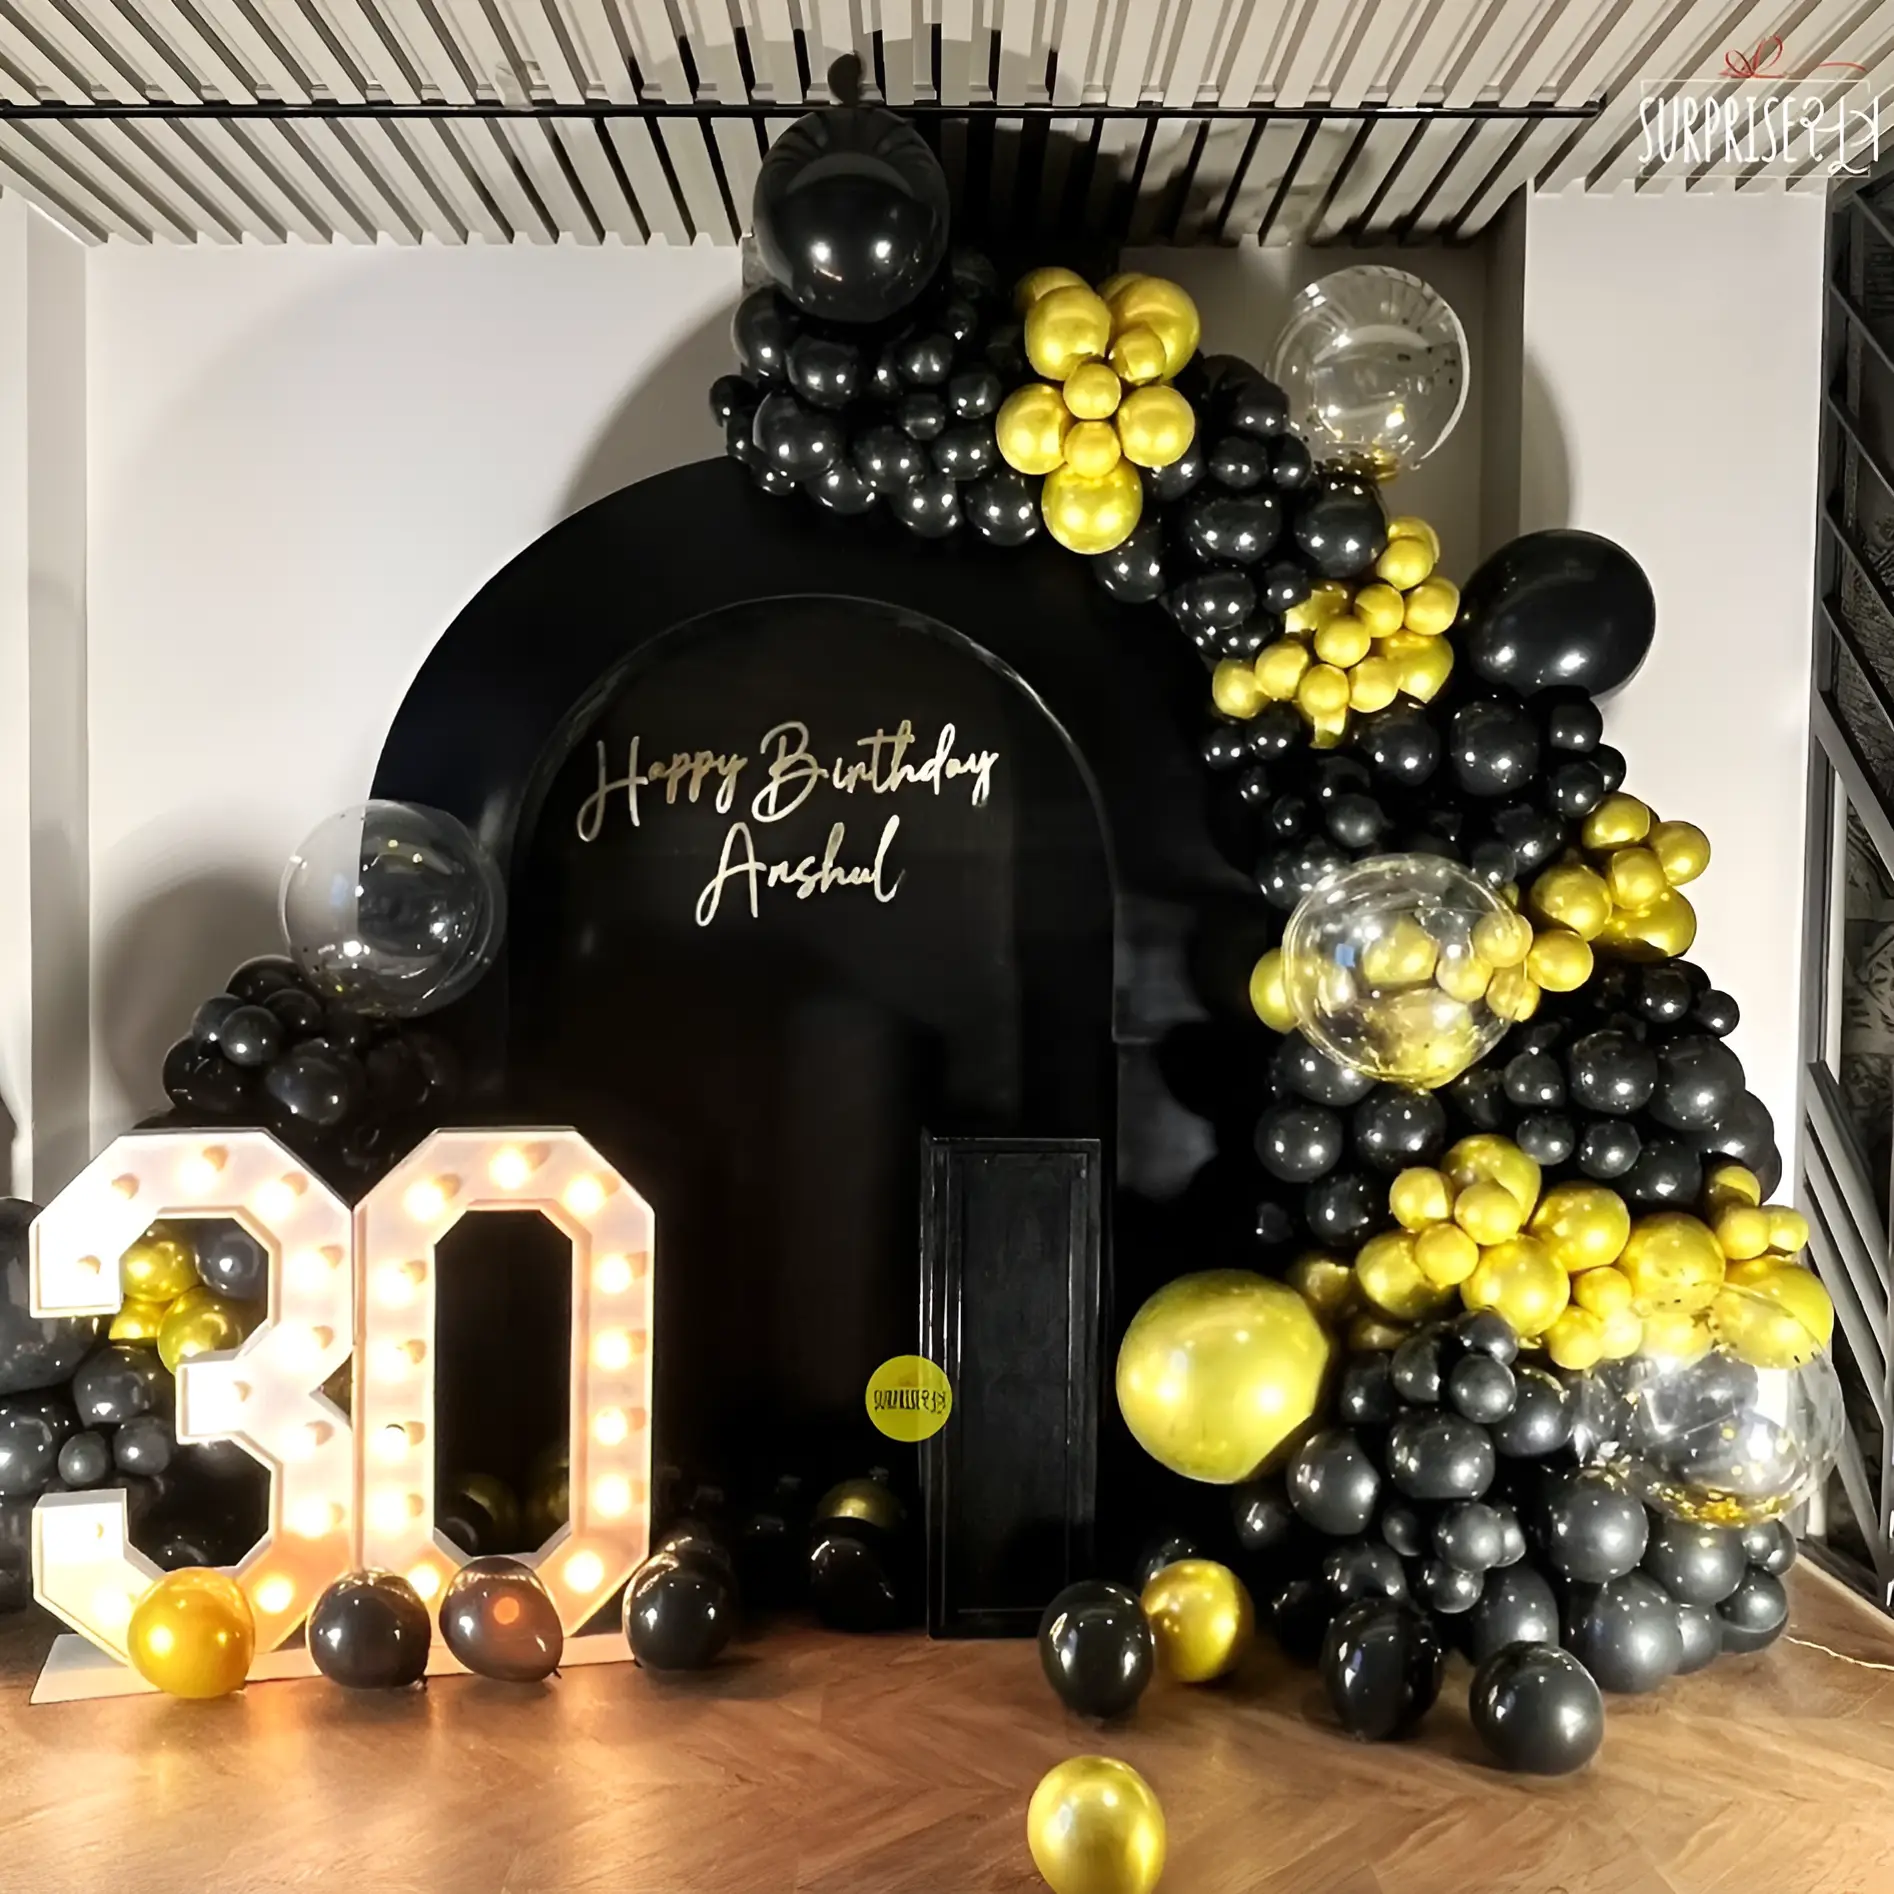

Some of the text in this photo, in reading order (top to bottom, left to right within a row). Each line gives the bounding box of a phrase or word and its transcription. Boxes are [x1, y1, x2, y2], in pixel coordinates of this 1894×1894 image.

[576, 719, 1000, 843] Happy Birthday
[694, 814, 906, 928] Anshul
[28, 1127, 655, 1666] 30
